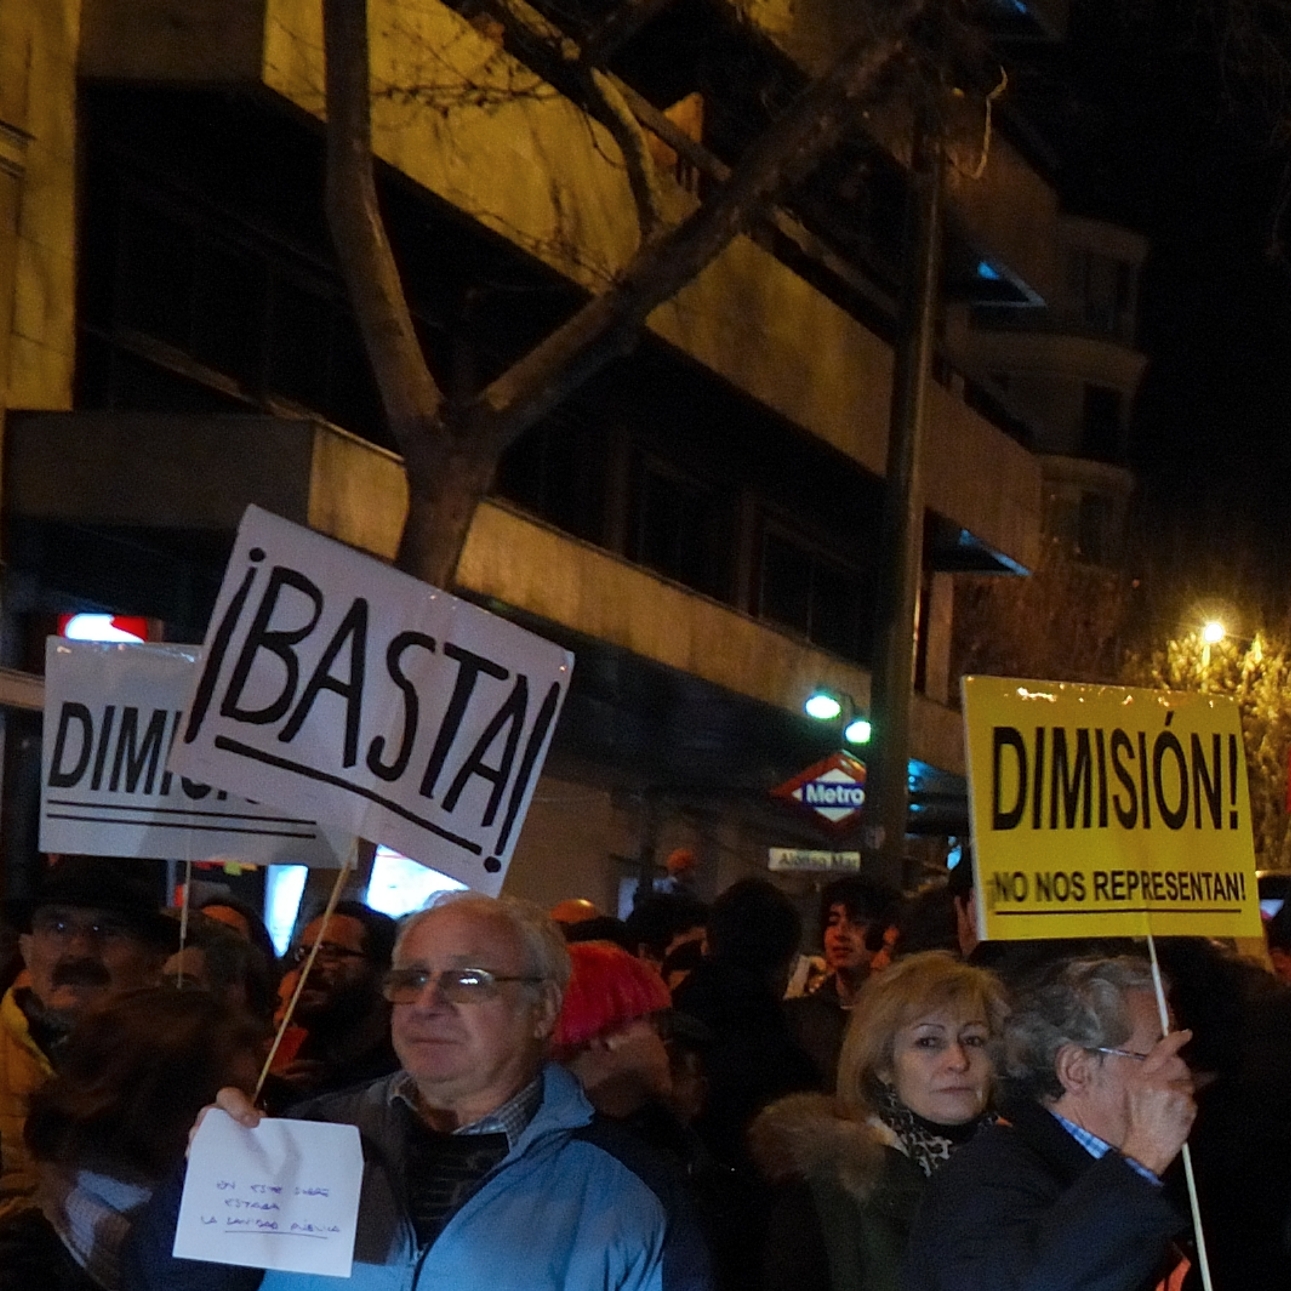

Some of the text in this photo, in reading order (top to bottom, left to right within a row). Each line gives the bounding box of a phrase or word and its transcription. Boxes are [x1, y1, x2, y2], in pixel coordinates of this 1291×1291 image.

[185, 547, 561, 873] ¡BASTA!
[805, 783, 866, 806] Metro
[990, 710, 1239, 831] DIMISIÓN!
[1035, 870, 1086, 902] NOS
[1093, 870, 1246, 902] REPRESENTAN!
